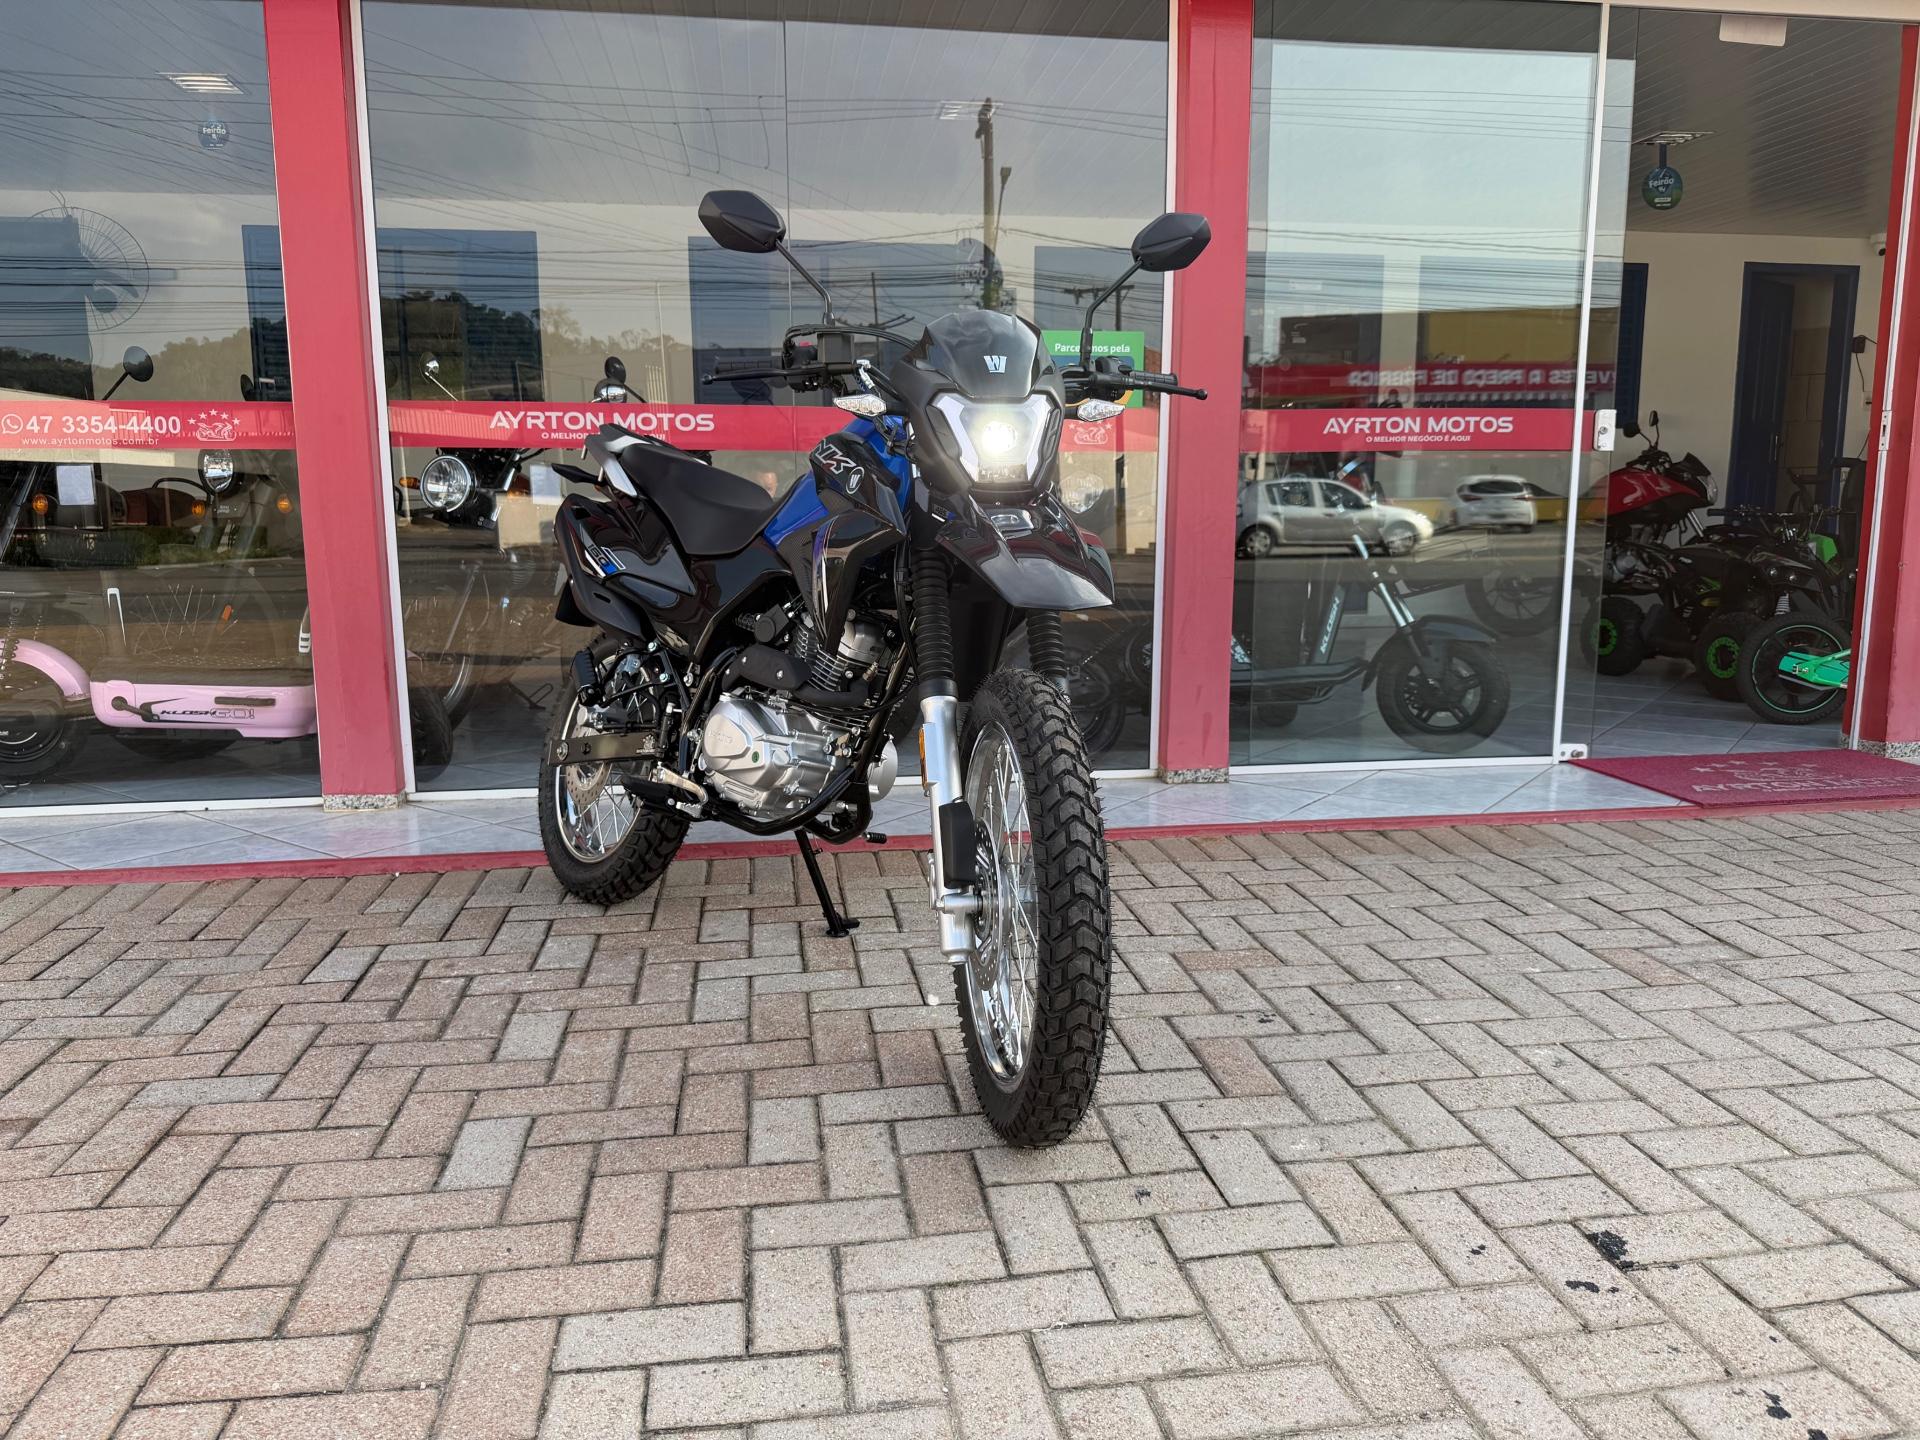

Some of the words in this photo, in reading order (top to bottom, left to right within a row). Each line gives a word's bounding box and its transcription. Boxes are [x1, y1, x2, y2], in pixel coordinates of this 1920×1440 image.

[1648, 176, 1675, 189] Feirão
[1054, 343, 1109, 353] Parcemos
[1110, 343, 1131, 355] pela
[26, 416, 53, 433] 47
[62, 416, 181, 434] 3354-4400
[490, 411, 604, 430] AYRTON
[613, 412, 715, 431] MOTOS
[1322, 416, 1421, 434] AYRTON
[1427, 416, 1514, 433] MOTOS
[22, 437, 159, 446] www.ayrtonmotos.com.br
[541, 432, 550, 440] O
[1366, 435, 1373, 443] O
[1373, 435, 1407, 443] MELHOR
[1407, 434, 1444, 443] NEGÓCIO
